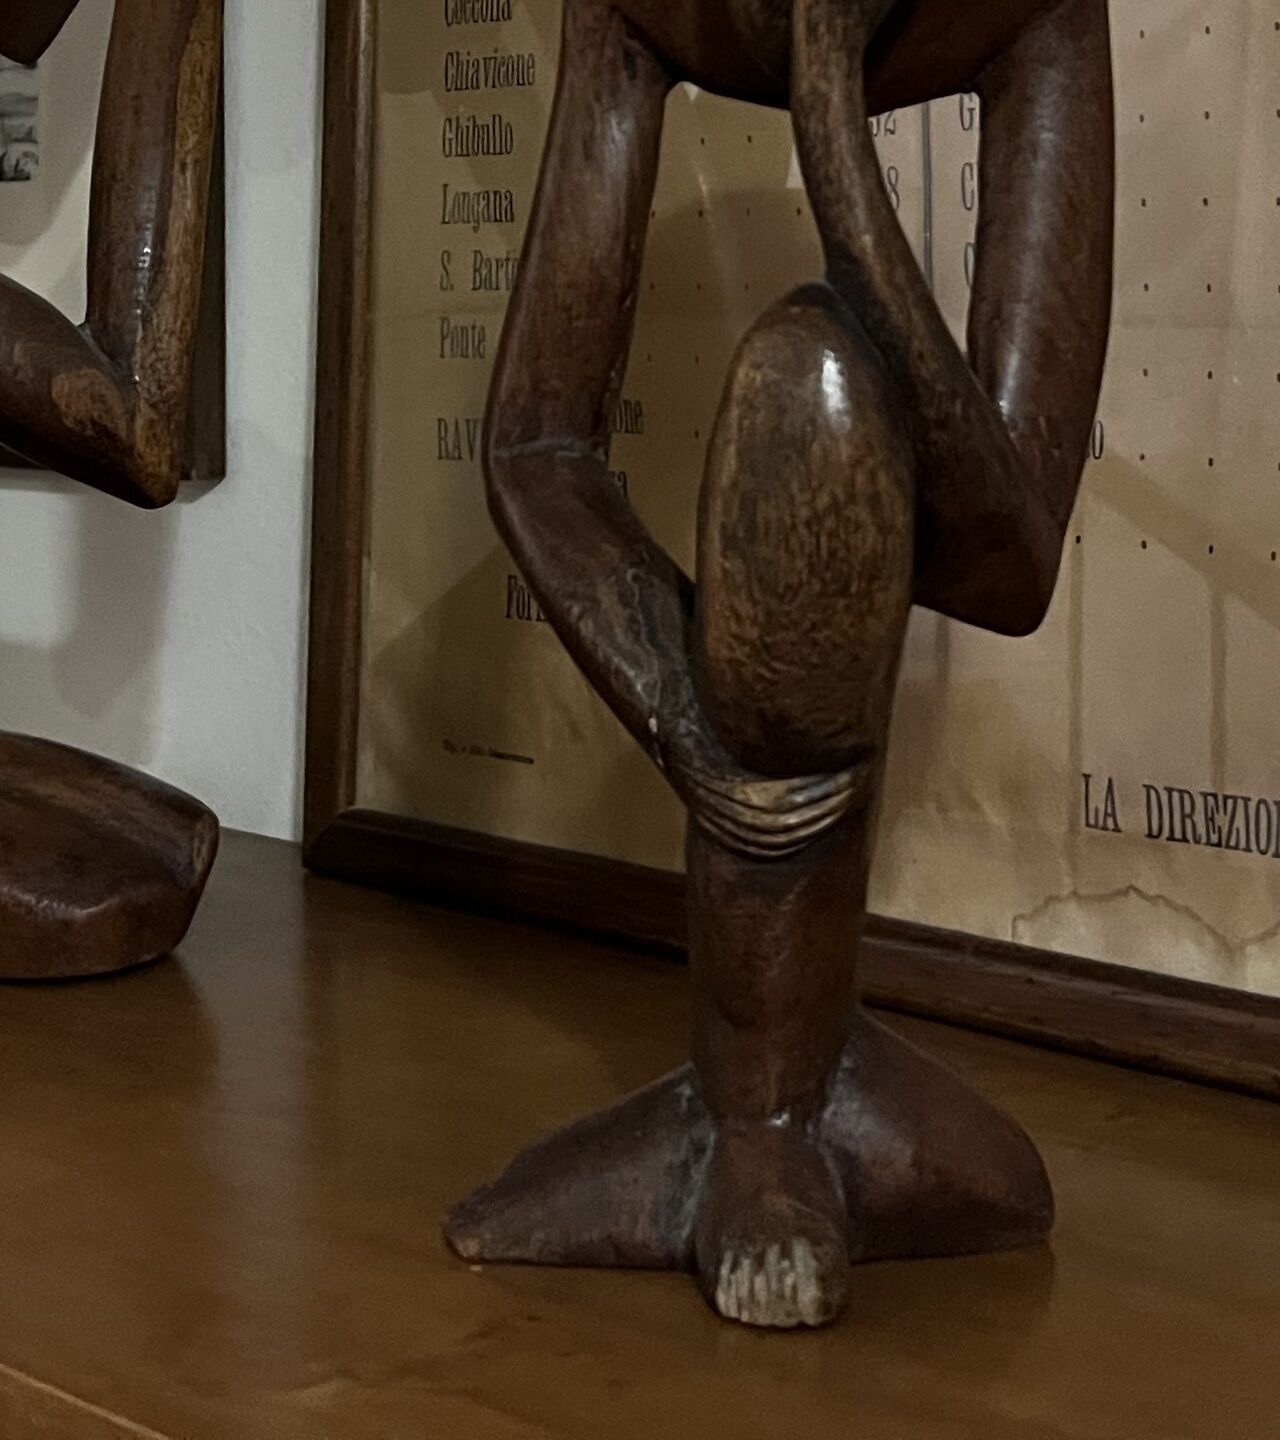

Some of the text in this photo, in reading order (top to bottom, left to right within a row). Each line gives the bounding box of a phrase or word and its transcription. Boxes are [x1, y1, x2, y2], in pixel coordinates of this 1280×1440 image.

[441, 183, 515, 234] Longana
[439, 249, 455, 292] S.
[439, 316, 486, 359] Ponte
[1081, 772, 1122, 834] LA
